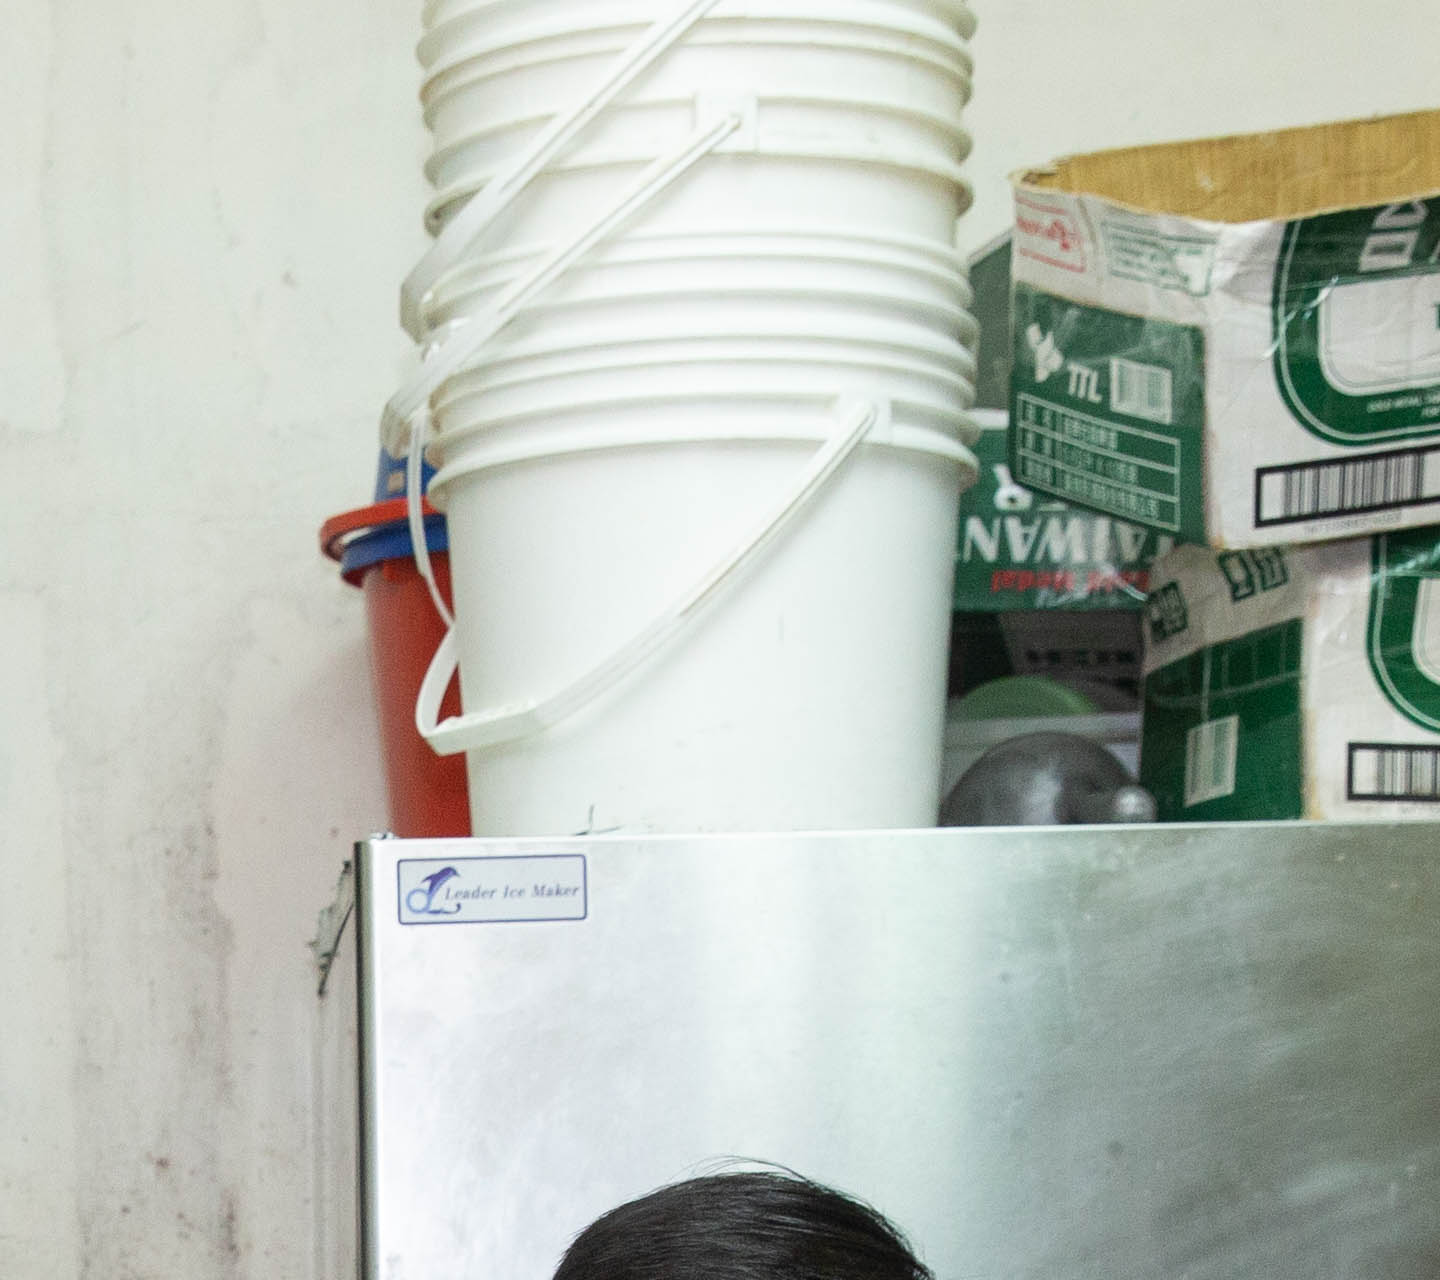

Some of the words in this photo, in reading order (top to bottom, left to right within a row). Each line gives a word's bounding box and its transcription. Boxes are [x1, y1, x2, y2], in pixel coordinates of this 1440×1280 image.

[445, 886, 496, 900] Leader
[503, 885, 525, 898] Ice
[531, 884, 579, 898] Maker
